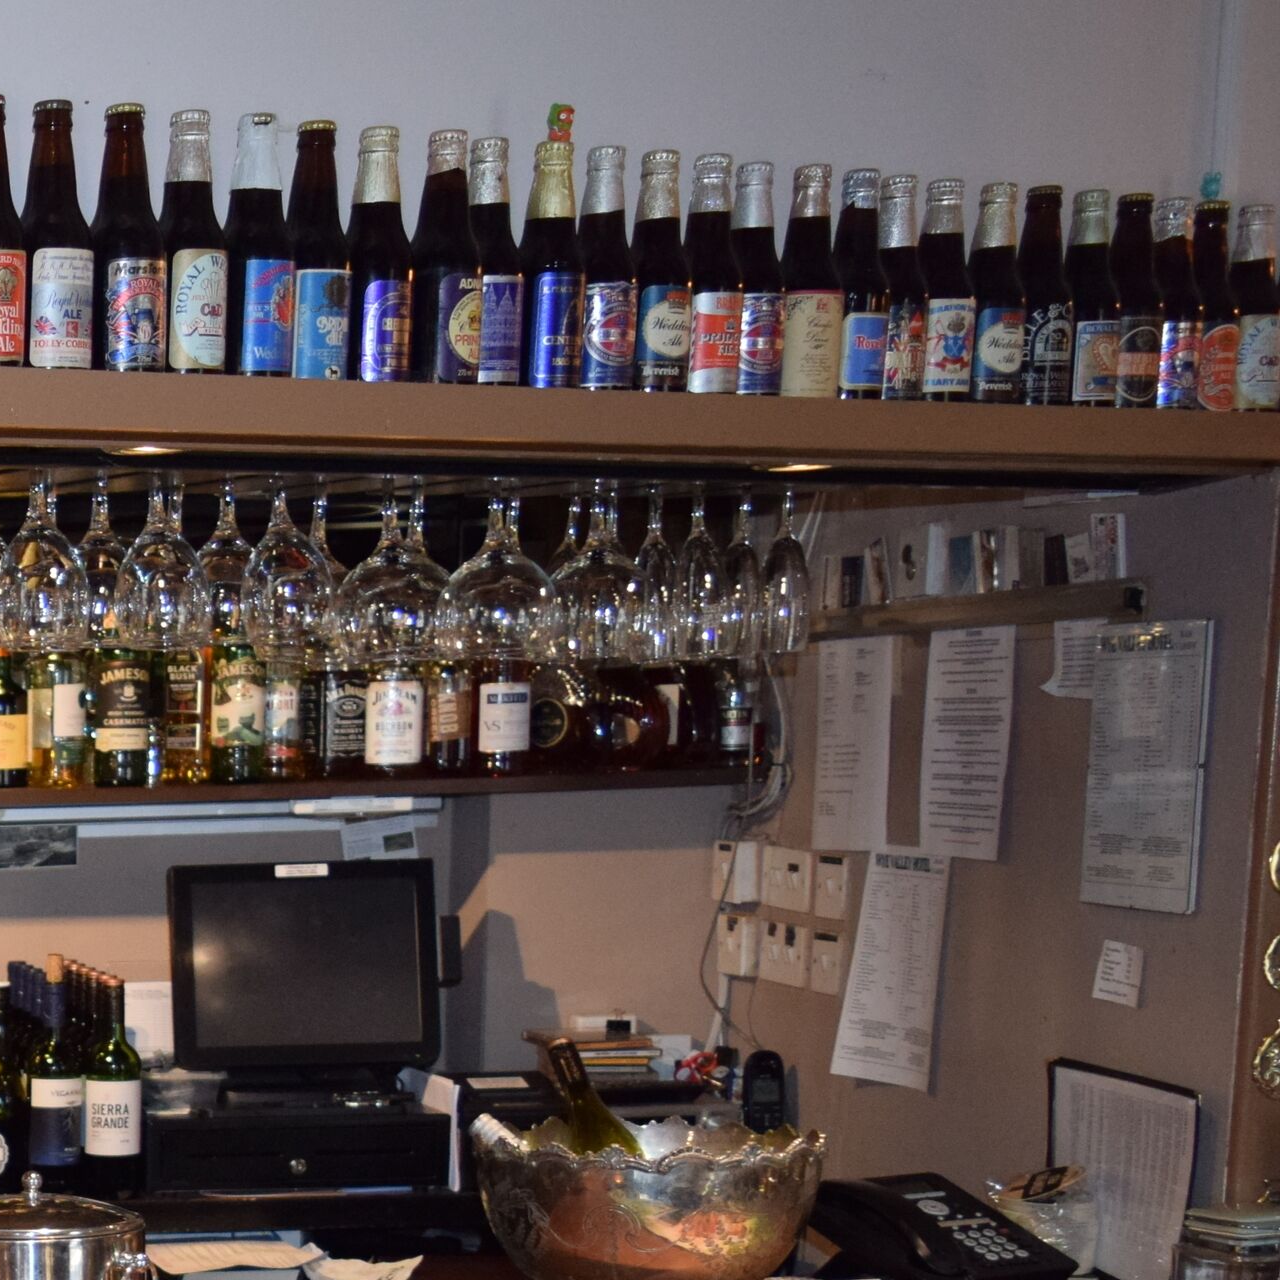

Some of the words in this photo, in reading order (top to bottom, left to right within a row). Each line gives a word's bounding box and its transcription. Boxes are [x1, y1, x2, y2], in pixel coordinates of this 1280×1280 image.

[129, 277, 160, 289] ROYAL
[175, 262, 206, 317] ROYAL
[61, 308, 83, 320] ALE
[661, 336, 683, 348] Ale
[167, 664, 199, 675] BLACK
[100, 667, 150, 686] JAMESON
[483, 720, 502, 732] VS
[91, 1103, 130, 1116] SIERRA
[91, 1116, 130, 1130] GRANDE
